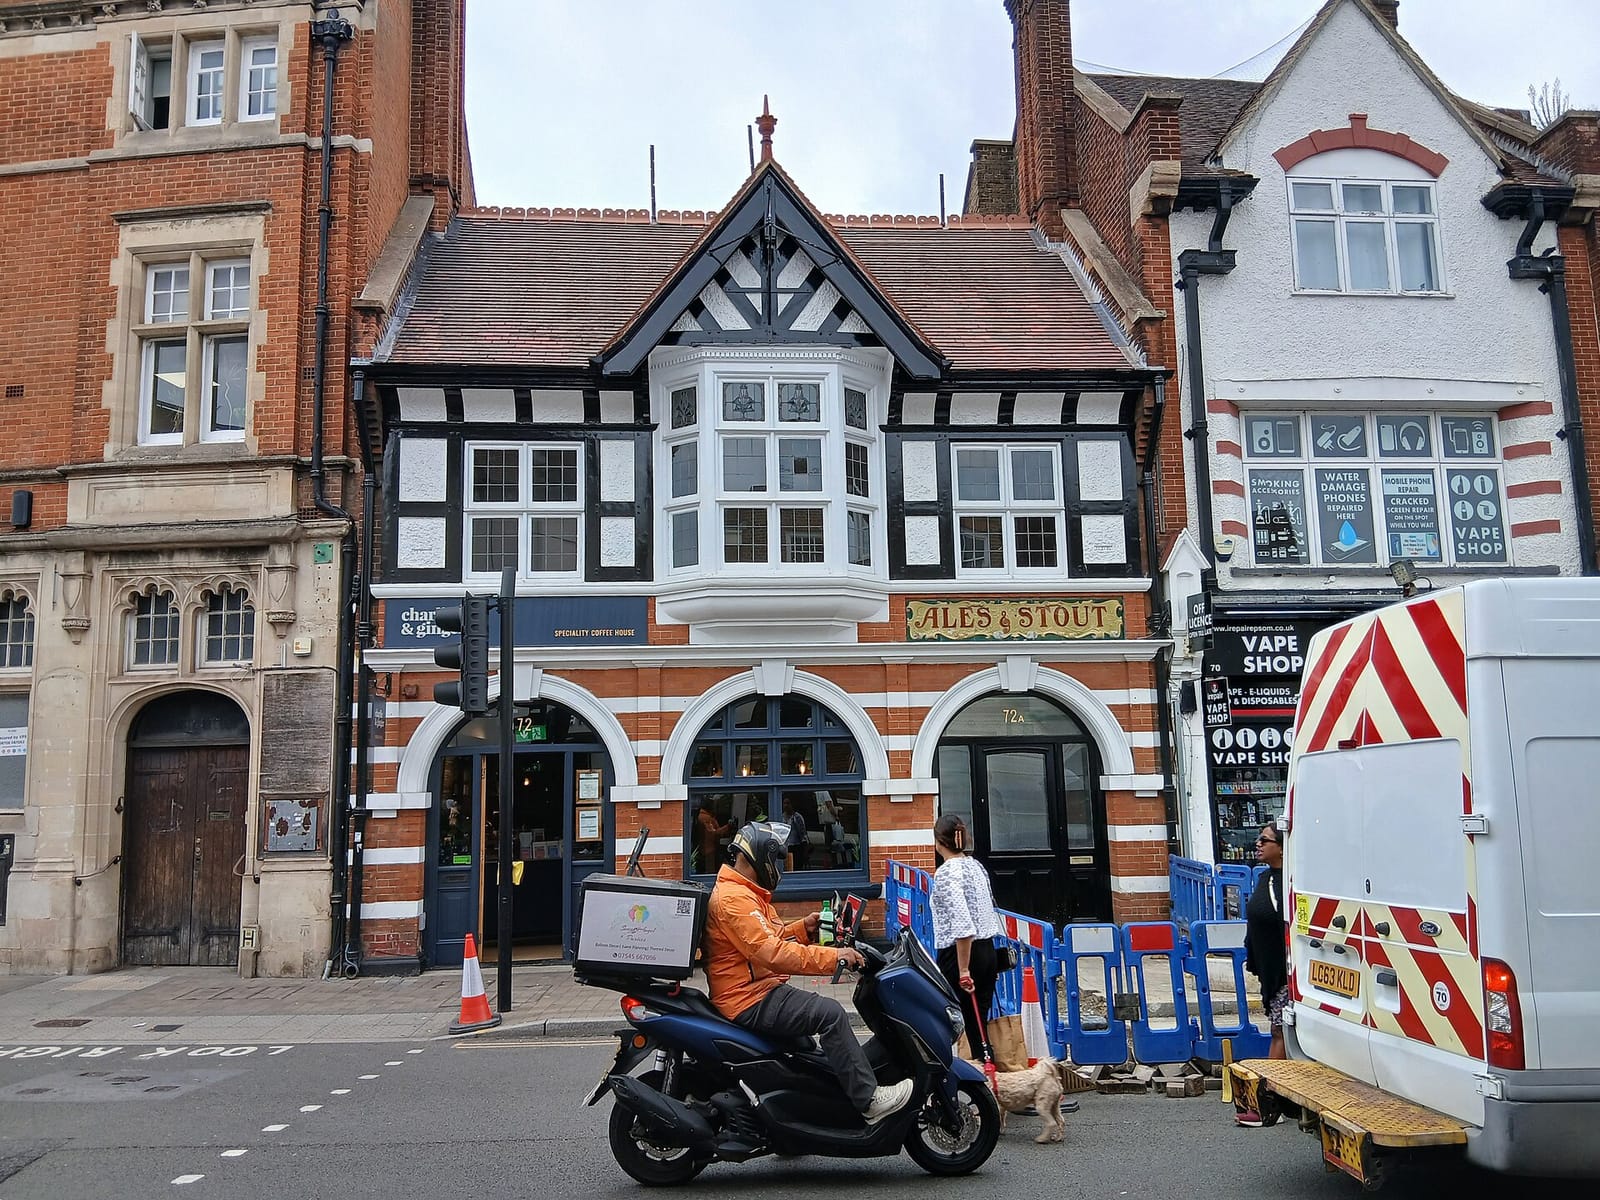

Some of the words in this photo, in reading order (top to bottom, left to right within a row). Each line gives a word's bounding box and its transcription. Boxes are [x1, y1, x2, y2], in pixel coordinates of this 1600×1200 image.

[1325, 472, 1360, 481] WATER
[1385, 477, 1408, 485] MOBILE
[1409, 477, 1431, 485] PHONE
[1251, 478, 1300, 488] SMOKING
[1321, 482, 1366, 492] DAMAGE
[1323, 494, 1366, 503] PHONES
[1390, 497, 1430, 506] CRACKED
[1326, 504, 1364, 512] REPAIRED
[1455, 527, 1500, 539] VAPE
[1457, 542, 1503, 555] SHOP
[1193, 602, 1205, 616] OFF
[914, 605, 993, 630] ALES
[1018, 605, 1108, 629] STOUT
[1188, 613, 1213, 629] LICENCE
[401, 622, 414, 636] &
[554, 629, 589, 637] SPECIALITY
[590, 629, 613, 637] COFFEE
[614, 629, 635, 637] HOUSE
[1241, 635, 1298, 652] VAPE
[1210, 664, 1221, 672] 70
[1243, 656, 1304, 673] SHOP
[1249, 688, 1291, 696] E-LIQUIDS
[1241, 697, 1298, 705] DISPOSABLES
[1207, 703, 1227, 713] VAPE
[517, 717, 532, 732] 72
[1207, 714, 1228, 724] SHOP
[1212, 752, 1256, 764] VAPE
[1261, 752, 1291, 764] SHO
[1336, 968, 1355, 992] KLD
[1436, 991, 1447, 1003] 70
[138, 1045, 295, 1058] LOOK
